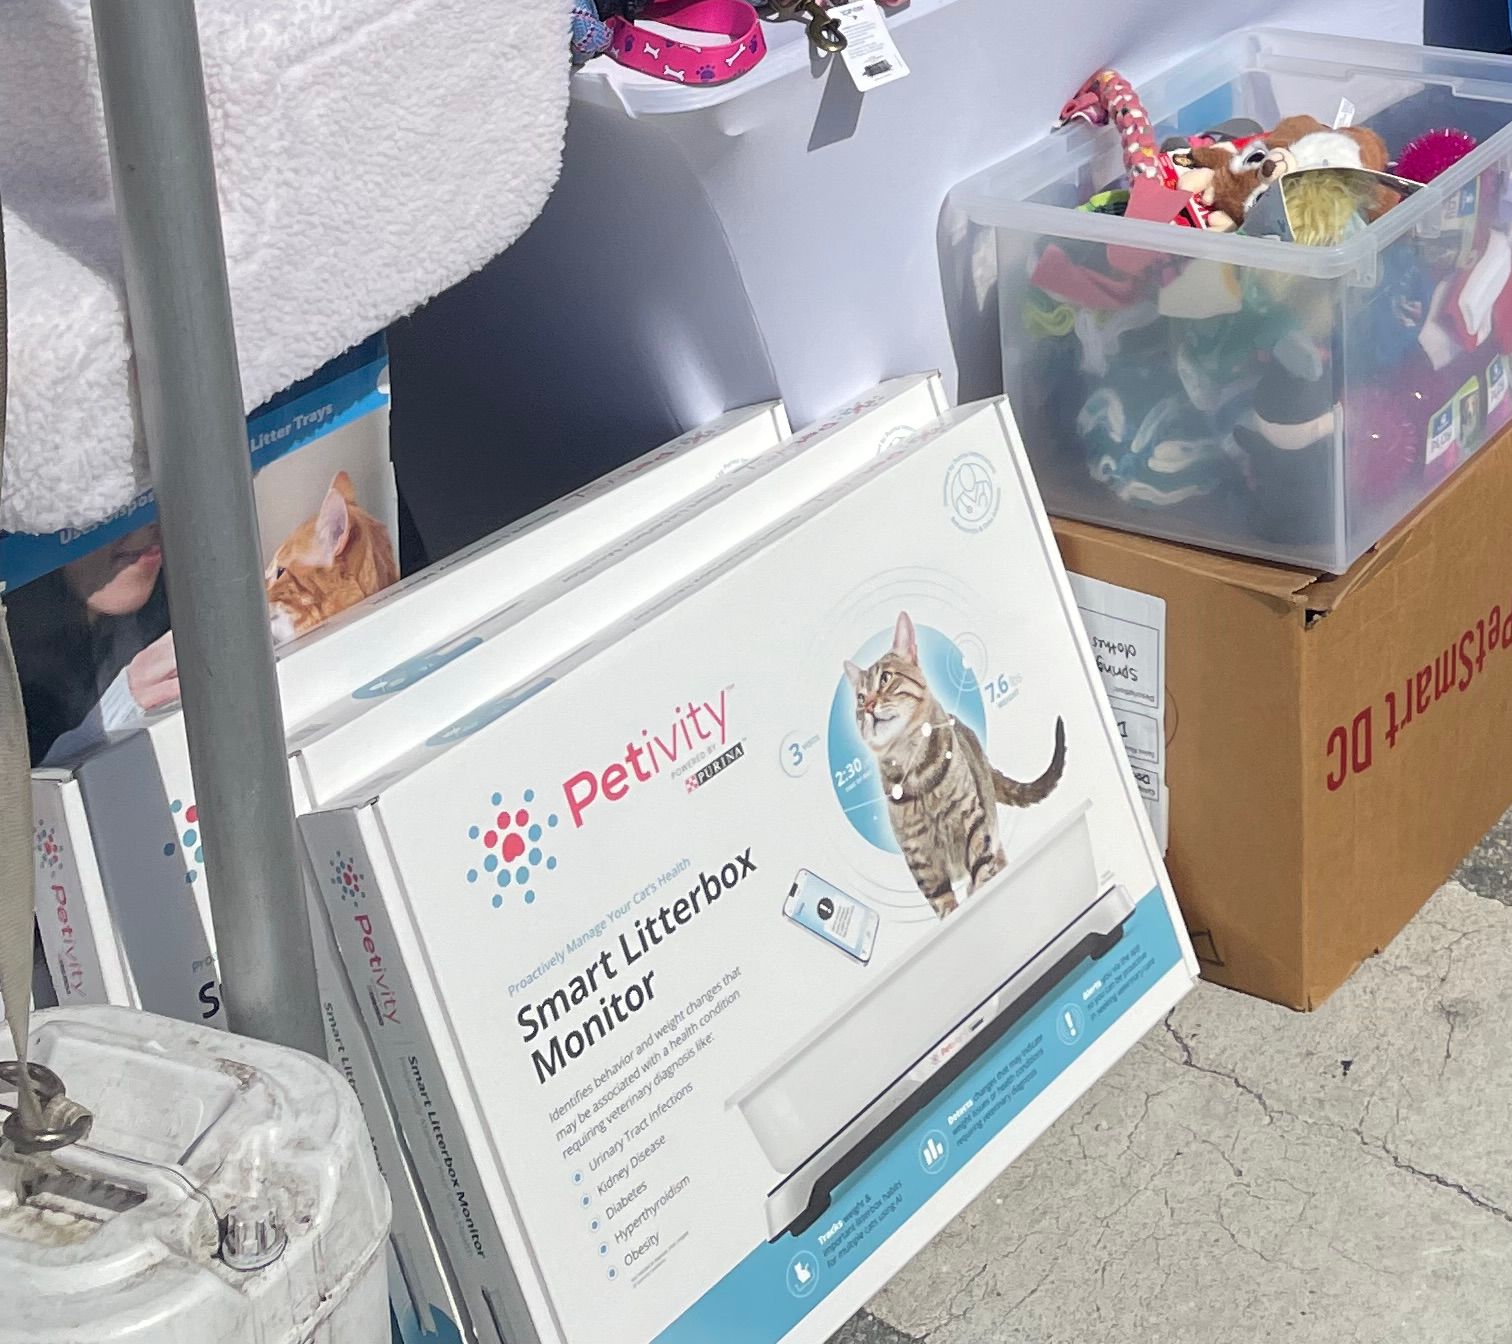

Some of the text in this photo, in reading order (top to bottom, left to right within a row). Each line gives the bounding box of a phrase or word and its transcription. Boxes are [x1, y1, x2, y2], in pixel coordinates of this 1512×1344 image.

[250, 403, 334, 453] Litter Trays
[1092, 635, 1137, 659] clothes
[984, 674, 1010, 704] 7.6
[562, 690, 726, 828] Petivity
[698, 742, 744, 786] PURINA
[788, 742, 803, 766] 3
[834, 757, 863, 788] 2:30
[1326, 705, 1373, 792] DC
[51, 884, 88, 999] Petivity
[507, 856, 691, 997] Proactively Manage Your Cat's Health
[517, 846, 757, 1043] Smart Litterbox
[353, 914, 401, 1026] Petivity
[323, 1001, 345, 1054] Smart
[530, 970, 655, 1085] Monitor
[549, 965, 742, 1124] Identifies behavior and weight changes that
[555, 988, 741, 1142] may be associated with a health condition
[562, 1031, 716, 1160] requiring veterinary diagnosis like:
[588, 1082, 694, 1171] Urinary Tract Infections
[408, 1055, 487, 1260] Smart Litterbox Monitor
[597, 1134, 667, 1196] Kidney Disease
[605, 1181, 649, 1220] Diabetes
[614, 1175, 692, 1245] Hyperthyroidism
[818, 1220, 844, 1246] Tracks
[624, 1232, 661, 1266] Obesity
